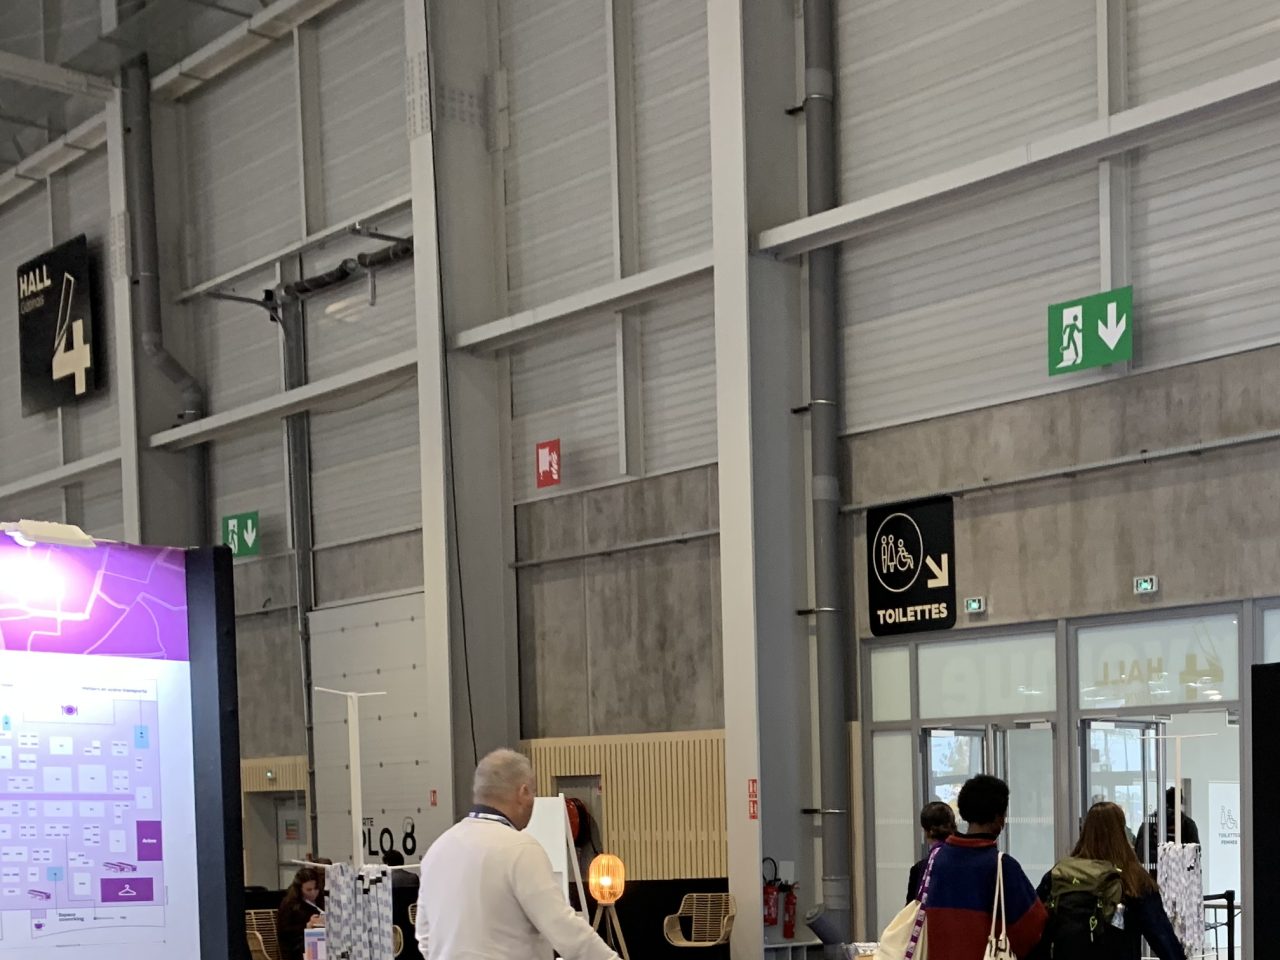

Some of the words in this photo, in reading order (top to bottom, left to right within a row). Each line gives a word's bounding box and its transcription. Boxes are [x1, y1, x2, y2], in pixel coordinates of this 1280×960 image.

[19, 264, 51, 299] HALL
[877, 602, 948, 624] TOILETTES
[402, 816, 417, 855] 8
